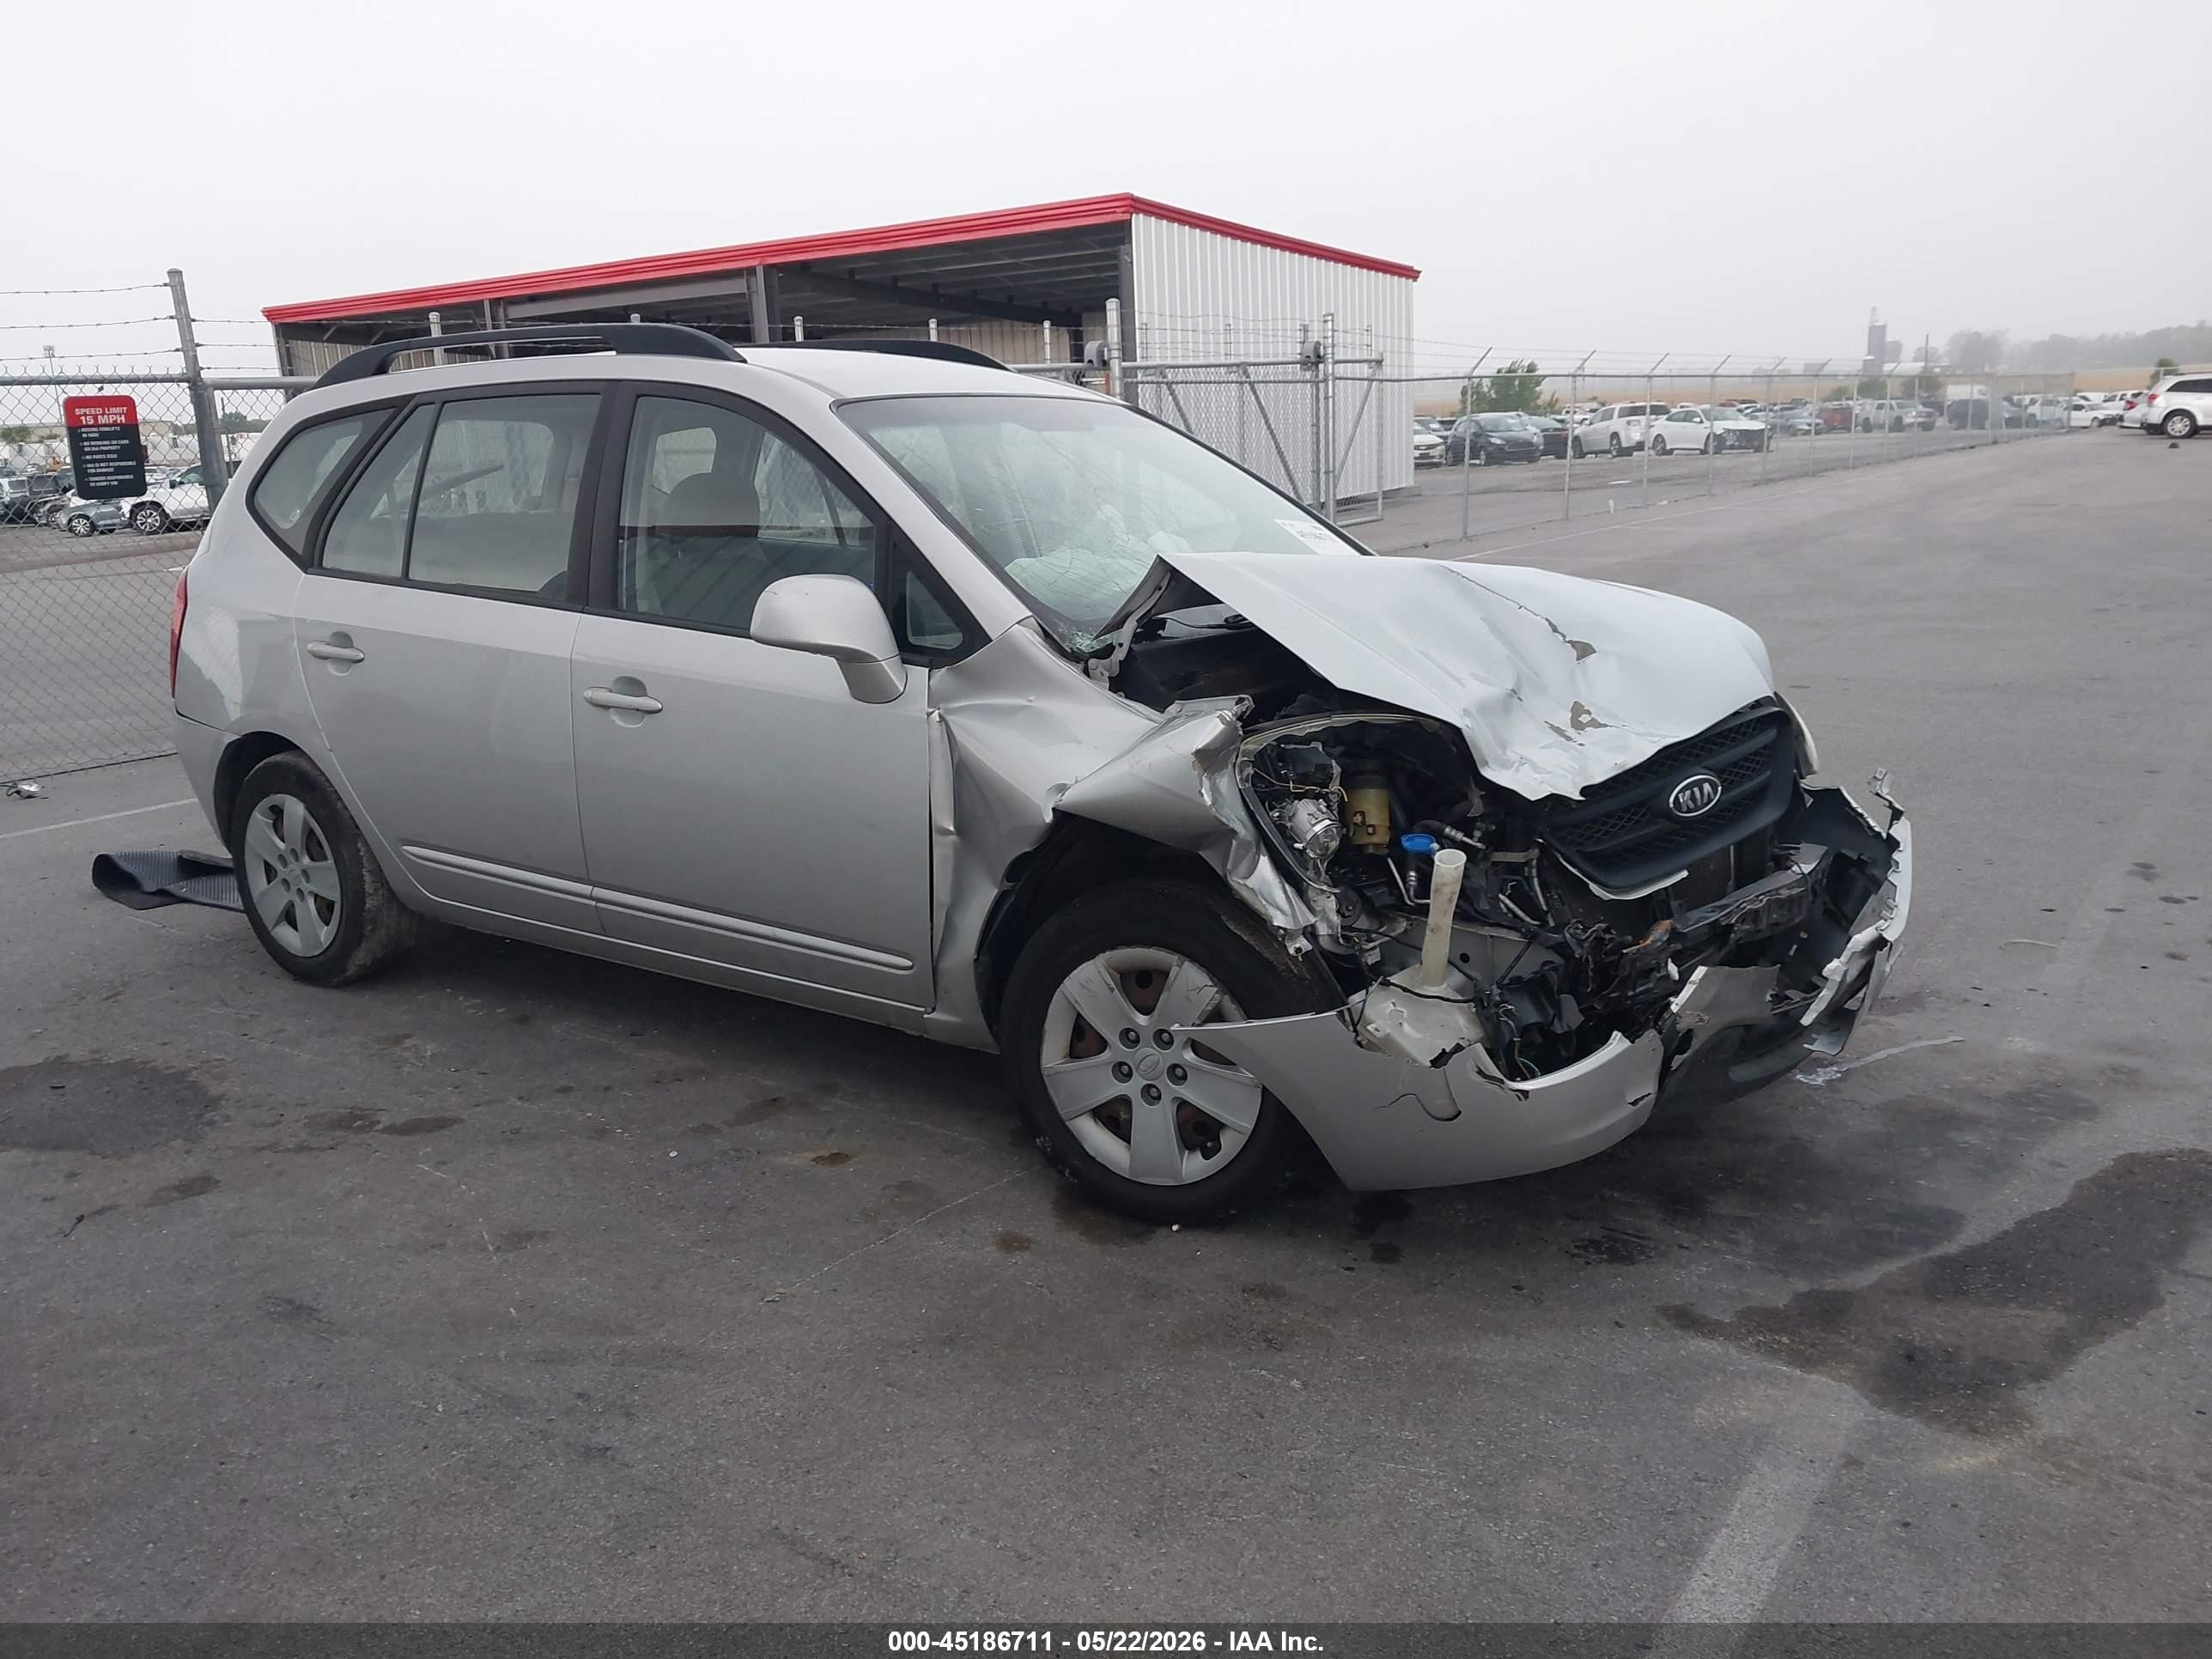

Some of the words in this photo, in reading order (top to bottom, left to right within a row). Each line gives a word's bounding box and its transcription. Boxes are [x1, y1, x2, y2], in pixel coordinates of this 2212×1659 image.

[74, 407, 103, 416] SPEED
[80, 416, 94, 425] 15
[97, 414, 125, 424] MPH
[1678, 781, 1715, 811] KIA
